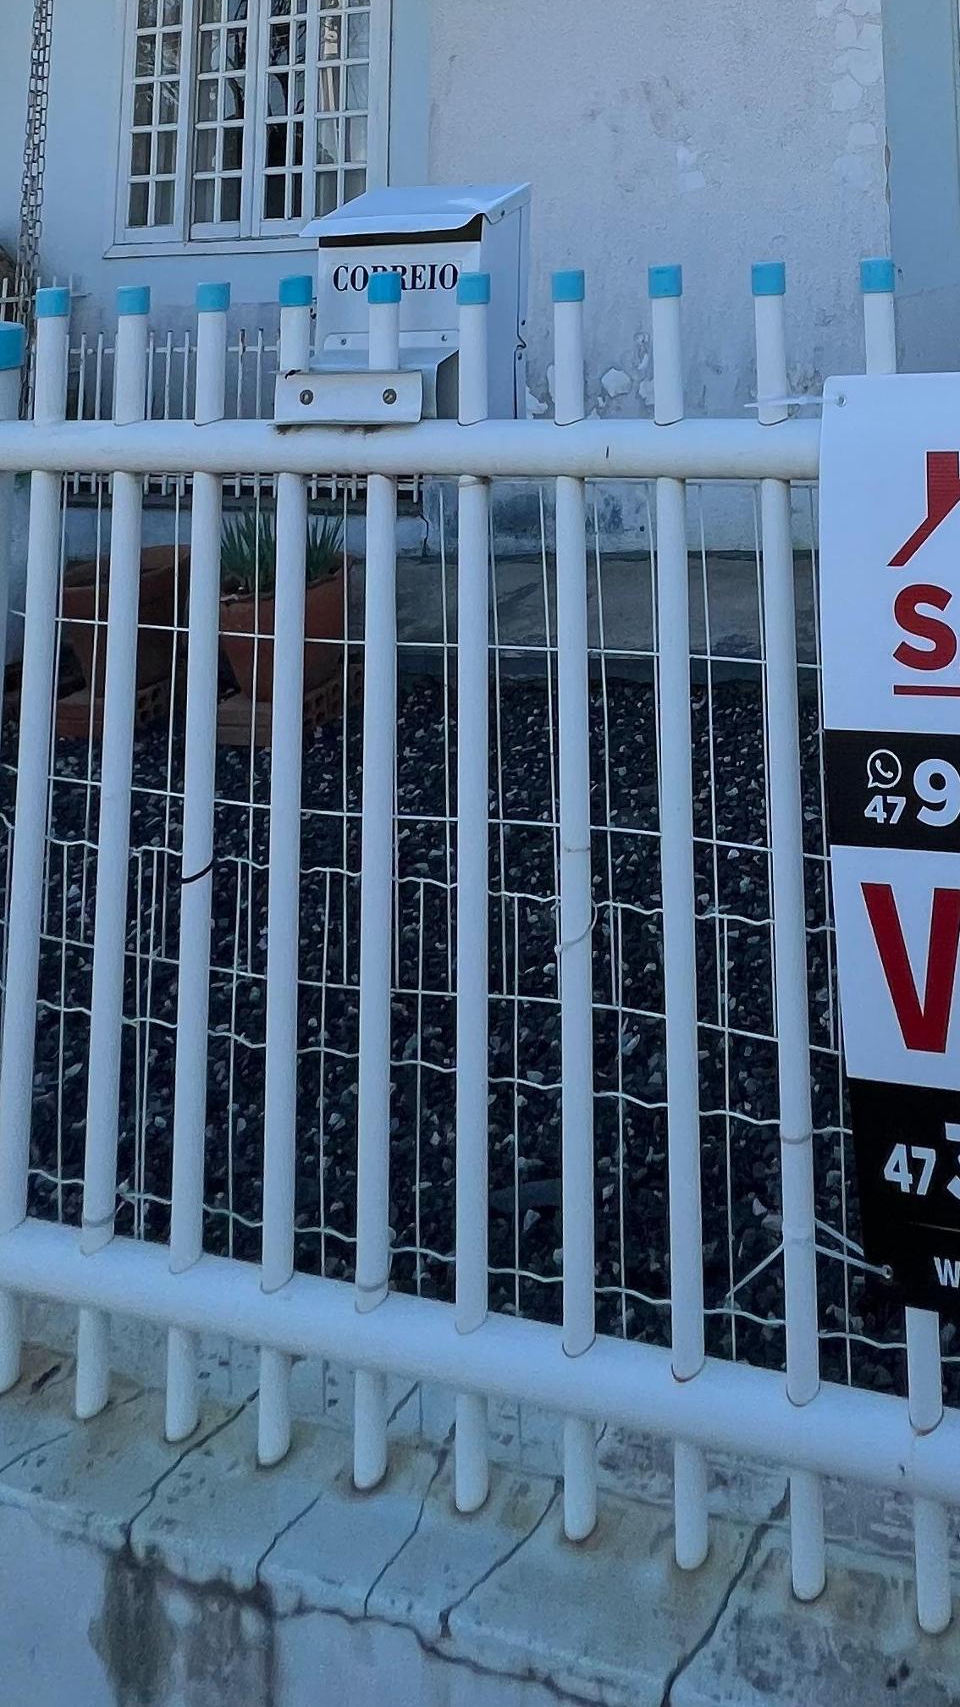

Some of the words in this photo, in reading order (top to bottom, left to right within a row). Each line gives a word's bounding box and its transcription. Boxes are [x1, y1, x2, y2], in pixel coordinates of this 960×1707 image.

[333, 263, 459, 292] COREIO
[863, 795, 907, 826] 47
[882, 1142, 938, 1196] 47
